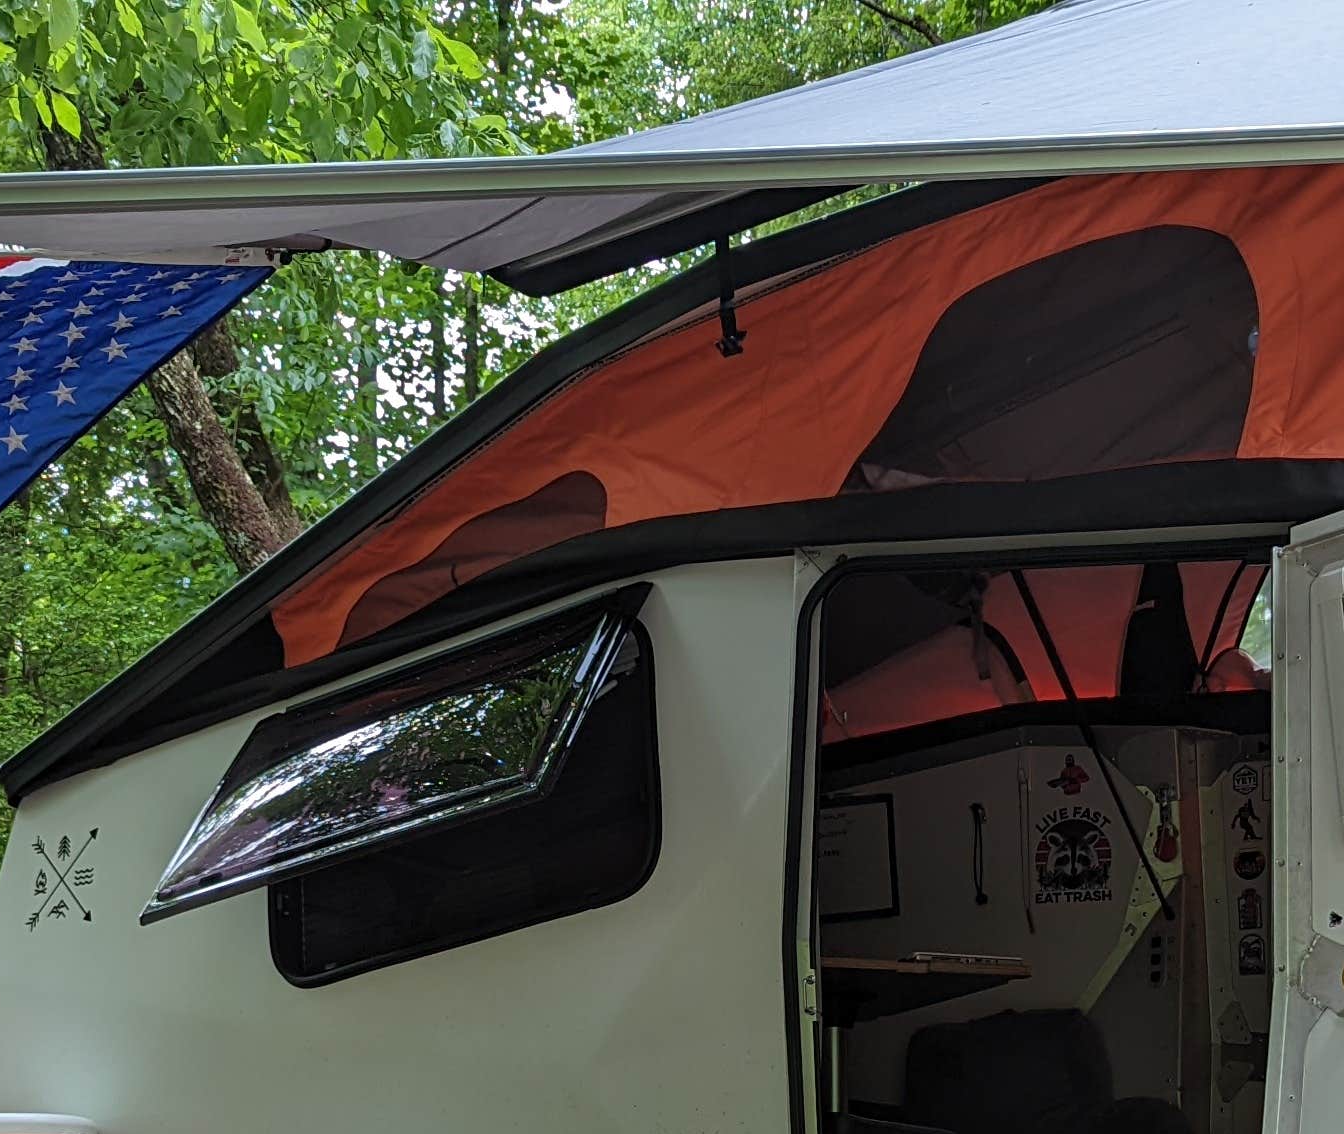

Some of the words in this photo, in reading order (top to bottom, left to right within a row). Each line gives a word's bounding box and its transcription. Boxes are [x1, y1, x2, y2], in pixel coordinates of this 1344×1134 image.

[1036, 807, 1069, 834] LIVE
[1073, 806, 1112, 828] FAST
[1035, 892, 1062, 904] EAT
[1064, 889, 1113, 903] TRASH
